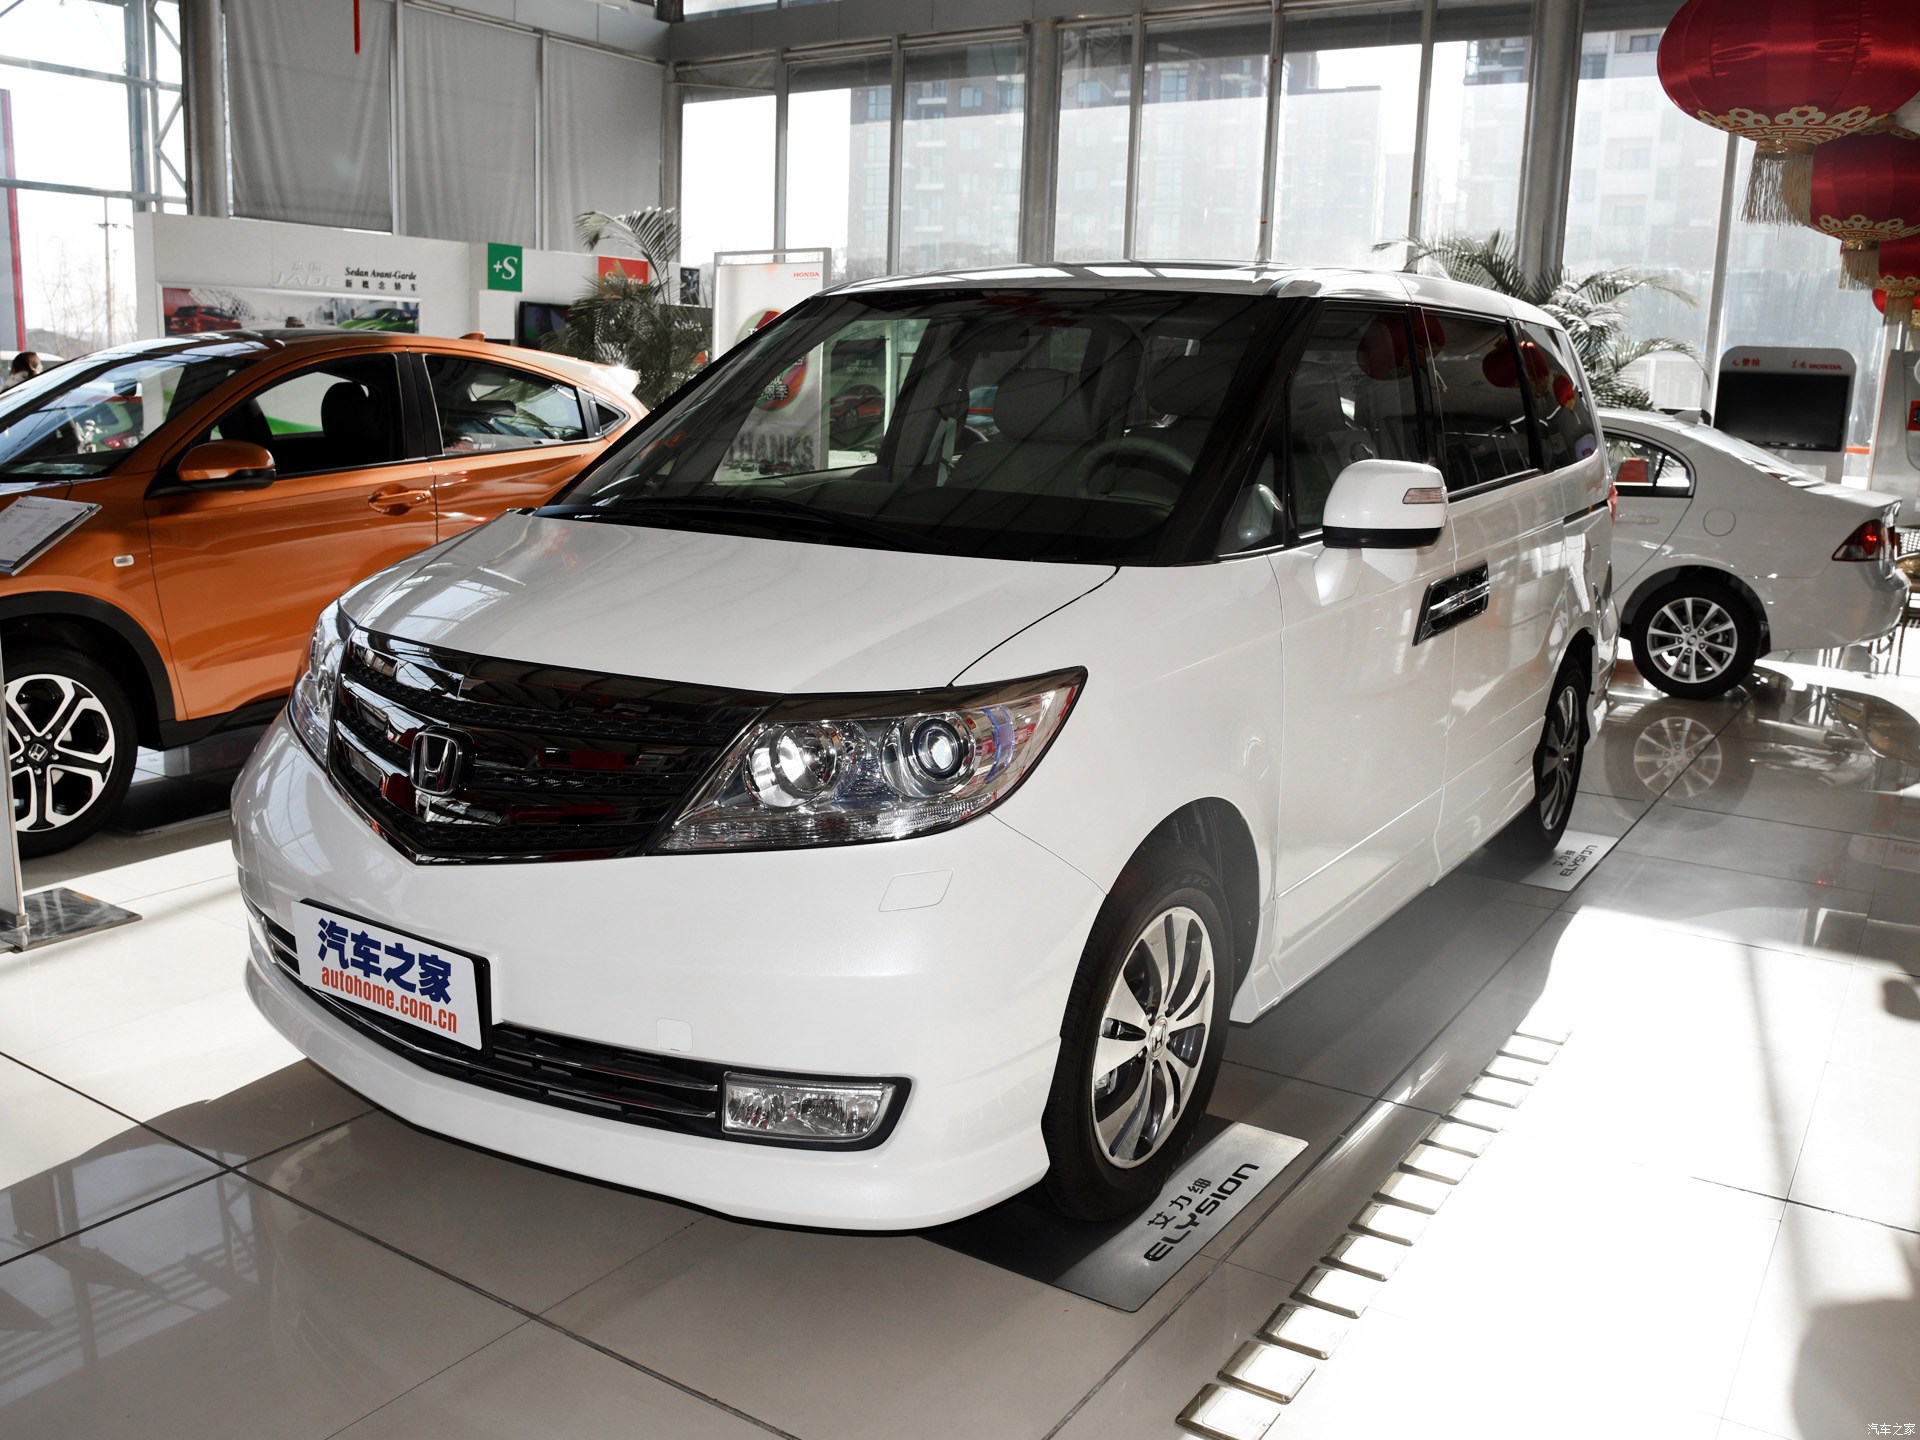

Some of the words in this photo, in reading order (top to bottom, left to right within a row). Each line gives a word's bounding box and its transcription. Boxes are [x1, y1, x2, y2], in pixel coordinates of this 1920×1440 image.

[1559, 845, 1598, 877] ELYSION
[318, 917, 452, 1005] 汽车之家
[322, 966, 457, 1034] autohome.com.cn
[1143, 1163, 1260, 1262] ELYSION
[1147, 1178, 1212, 1229] 艾力绅
